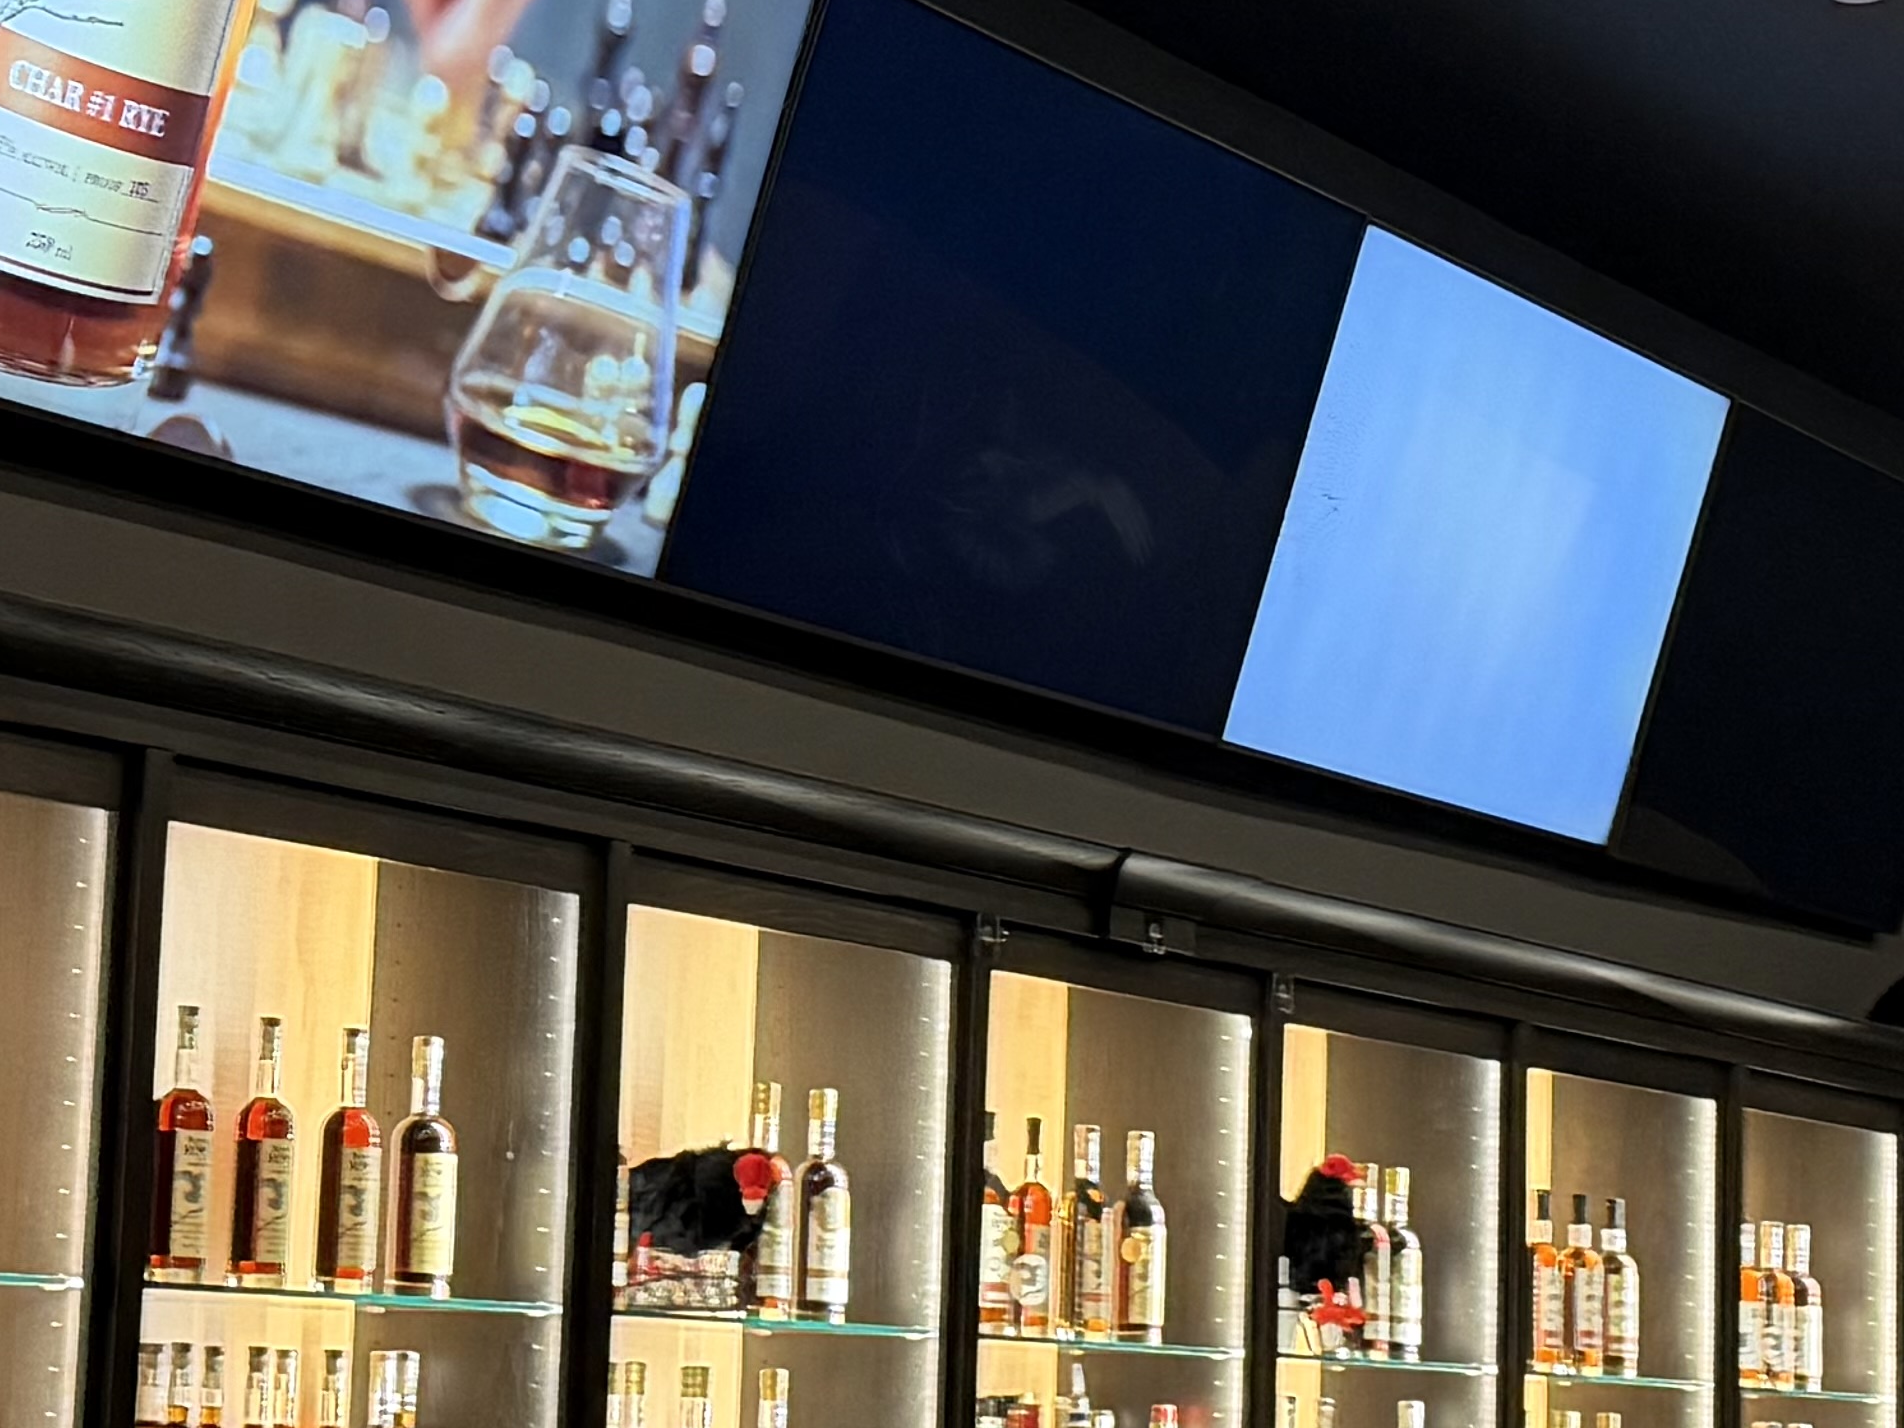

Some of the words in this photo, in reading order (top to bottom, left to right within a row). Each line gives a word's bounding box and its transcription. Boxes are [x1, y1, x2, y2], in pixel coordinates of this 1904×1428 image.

[9, 60, 84, 112] CHAR
[87, 91, 117, 122] #1
[119, 99, 170, 137] RYE
